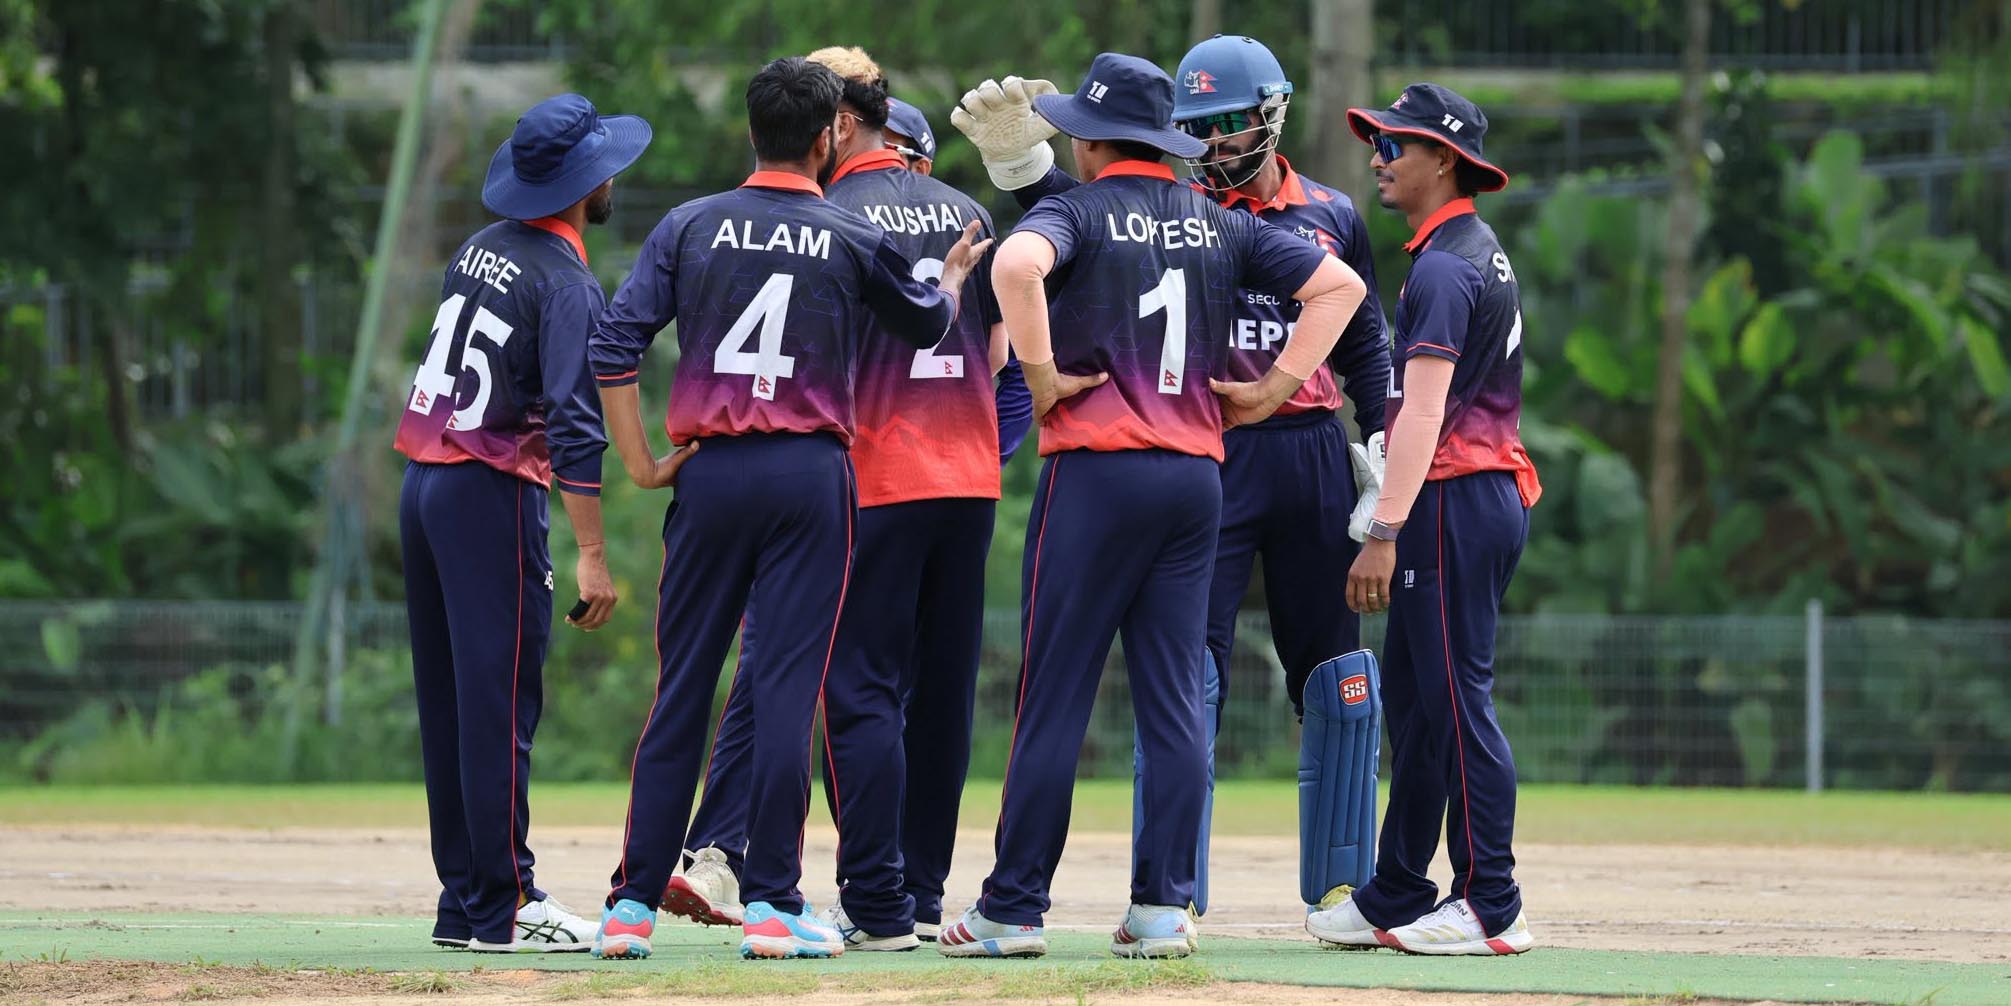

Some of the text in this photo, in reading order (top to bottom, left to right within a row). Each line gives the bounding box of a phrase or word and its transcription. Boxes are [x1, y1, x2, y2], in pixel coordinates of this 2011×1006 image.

[454, 245, 522, 295] AIREE
[711, 218, 832, 260] ALAM
[1107, 212, 1221, 250] LOKESH
[713, 273, 795, 401] 4
[910, 257, 964, 378] 2
[1139, 267, 1187, 395] 1
[408, 292, 514, 432] 45
[1343, 680, 1366, 699] SS
